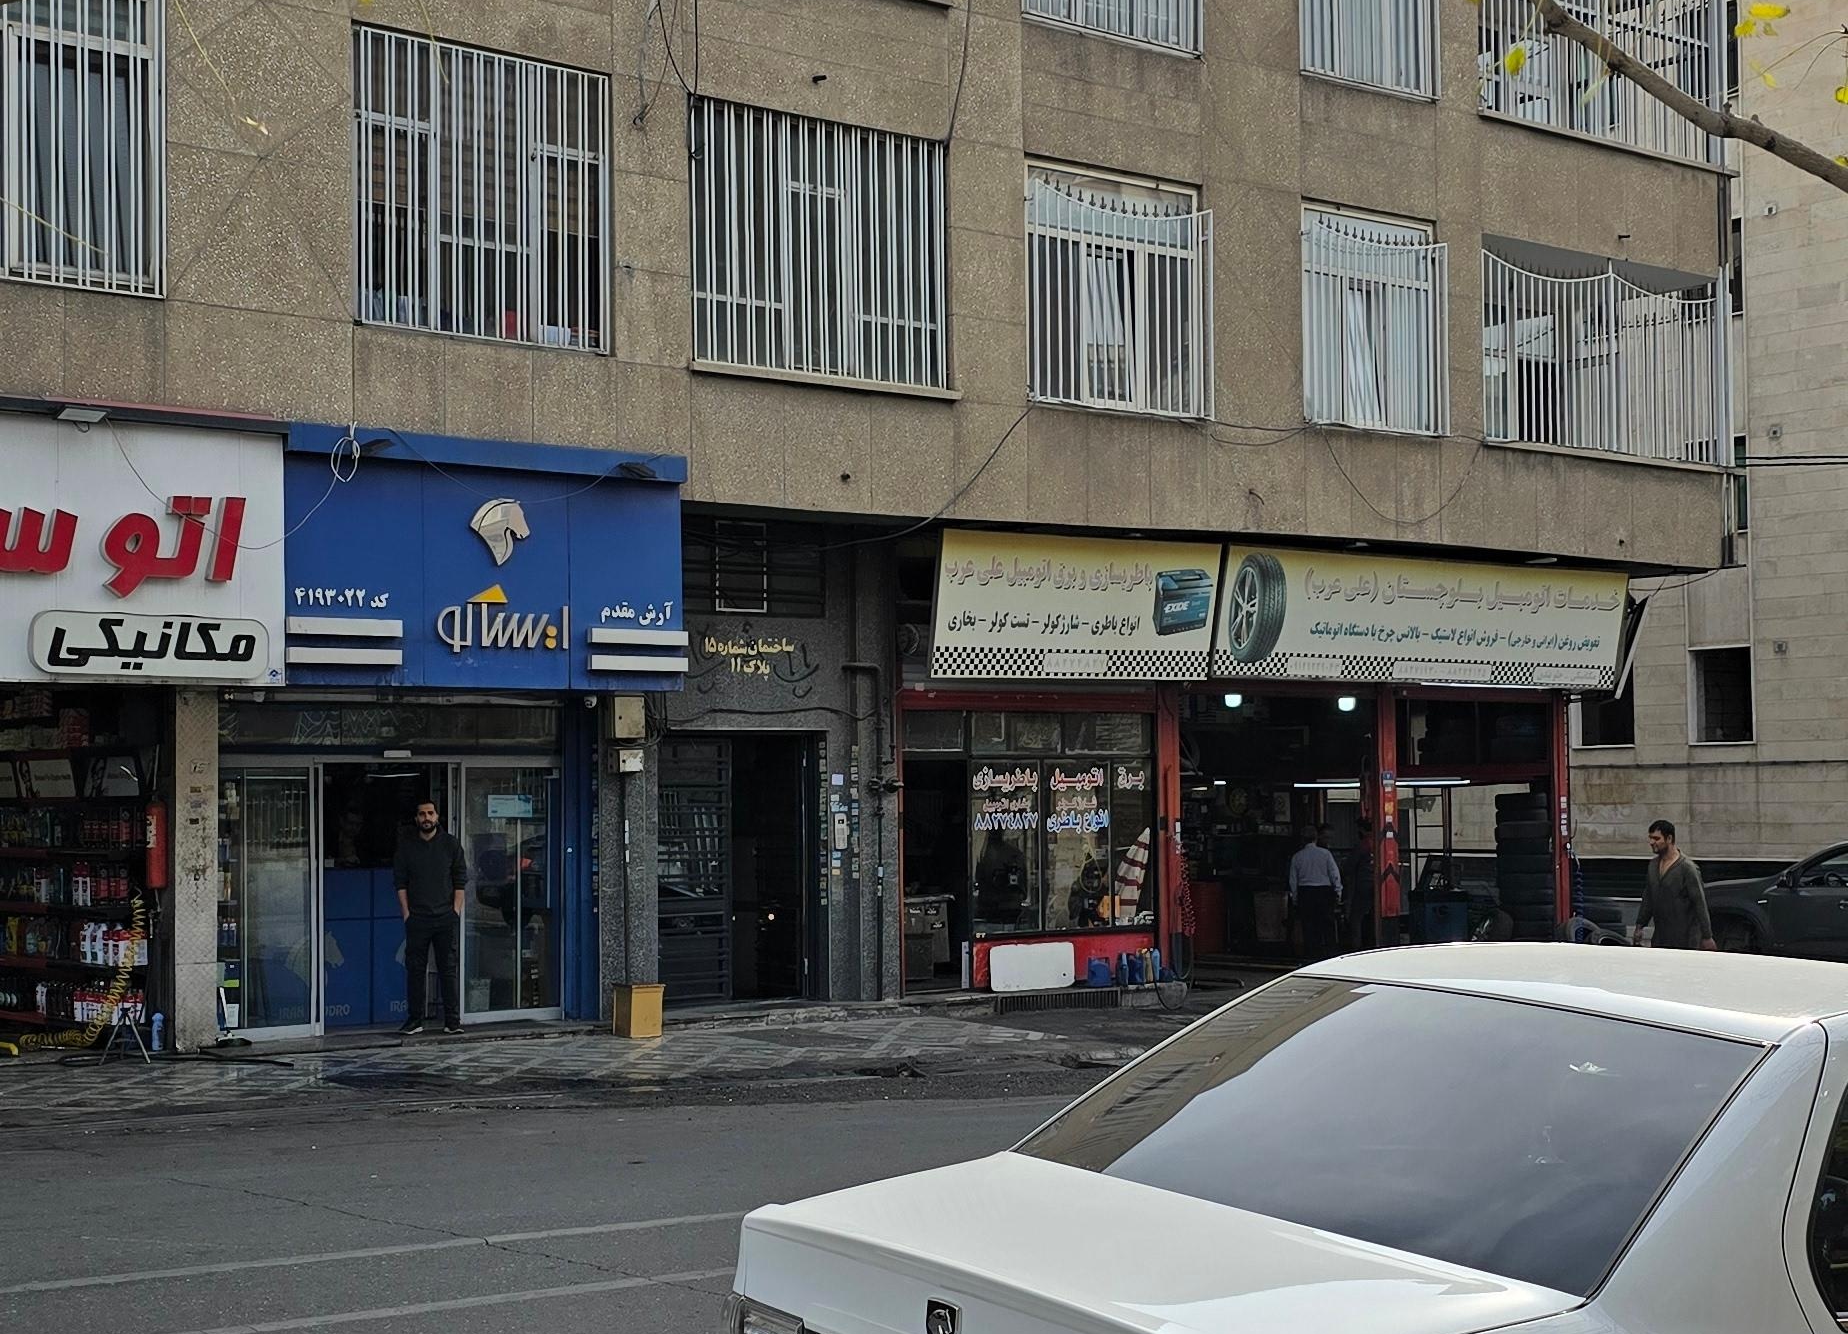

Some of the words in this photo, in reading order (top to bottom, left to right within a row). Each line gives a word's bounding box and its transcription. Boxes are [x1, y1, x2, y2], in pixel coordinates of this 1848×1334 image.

[100, 495, 247, 599] اتو
[944, 559, 975, 586] عرب
[976, 554, 1004, 586] علی
[1007, 556, 1052, 589] اتومبیل
[1053, 562, 1076, 590] برق
[1079, 569, 1086, 591] و
[1089, 561, 1153, 592] باطریسازی
[294, 586, 367, 608] ۴۱۹۳۰۲۲
[371, 591, 390, 609] کد
[1486, 580, 1552, 614] اتومبیل
[1553, 582, 1621, 611] خدمات
[437, 583, 569, 653] ایساکو
[599, 603, 636, 625] مقدم
[637, 600, 674, 626] آرش
[947, 610, 976, 632] بخاری
[988, 610, 1009, 633] کولر
[1010, 612, 1030, 628] تست
[1091, 614, 1118, 636] باطری
[1119, 615, 1141, 636] انواع
[1309, 621, 1343, 640] اتوماتیک
[1343, 623, 1370, 637] دستگاه
[1370, 623, 1377, 641] با
[1377, 625, 1395, 643] چرخ
[1396, 625, 1421, 643] بالانس
[1430, 627, 1457, 644] لاستیک
[47, 617, 257, 671] مکانیکی
[704, 636, 717, 653] ۱۵
[717, 638, 747, 656] شماره
[747, 636, 795, 656] ساختمان
[1456, 628, 1476, 647] انواع
[1476, 629, 1499, 647] فروش
[730, 656, 741, 673] ۱۱
[743, 658, 771, 682] پلاک
[972, 765, 1039, 793] باطریسازی
[1050, 766, 1104, 791] اتومبیل
[1117, 766, 1146, 791] برق
[1046, 810, 1083, 835] باطری
[1084, 808, 1111, 833] انواع
[389, 999, 408, 1013] IRA
